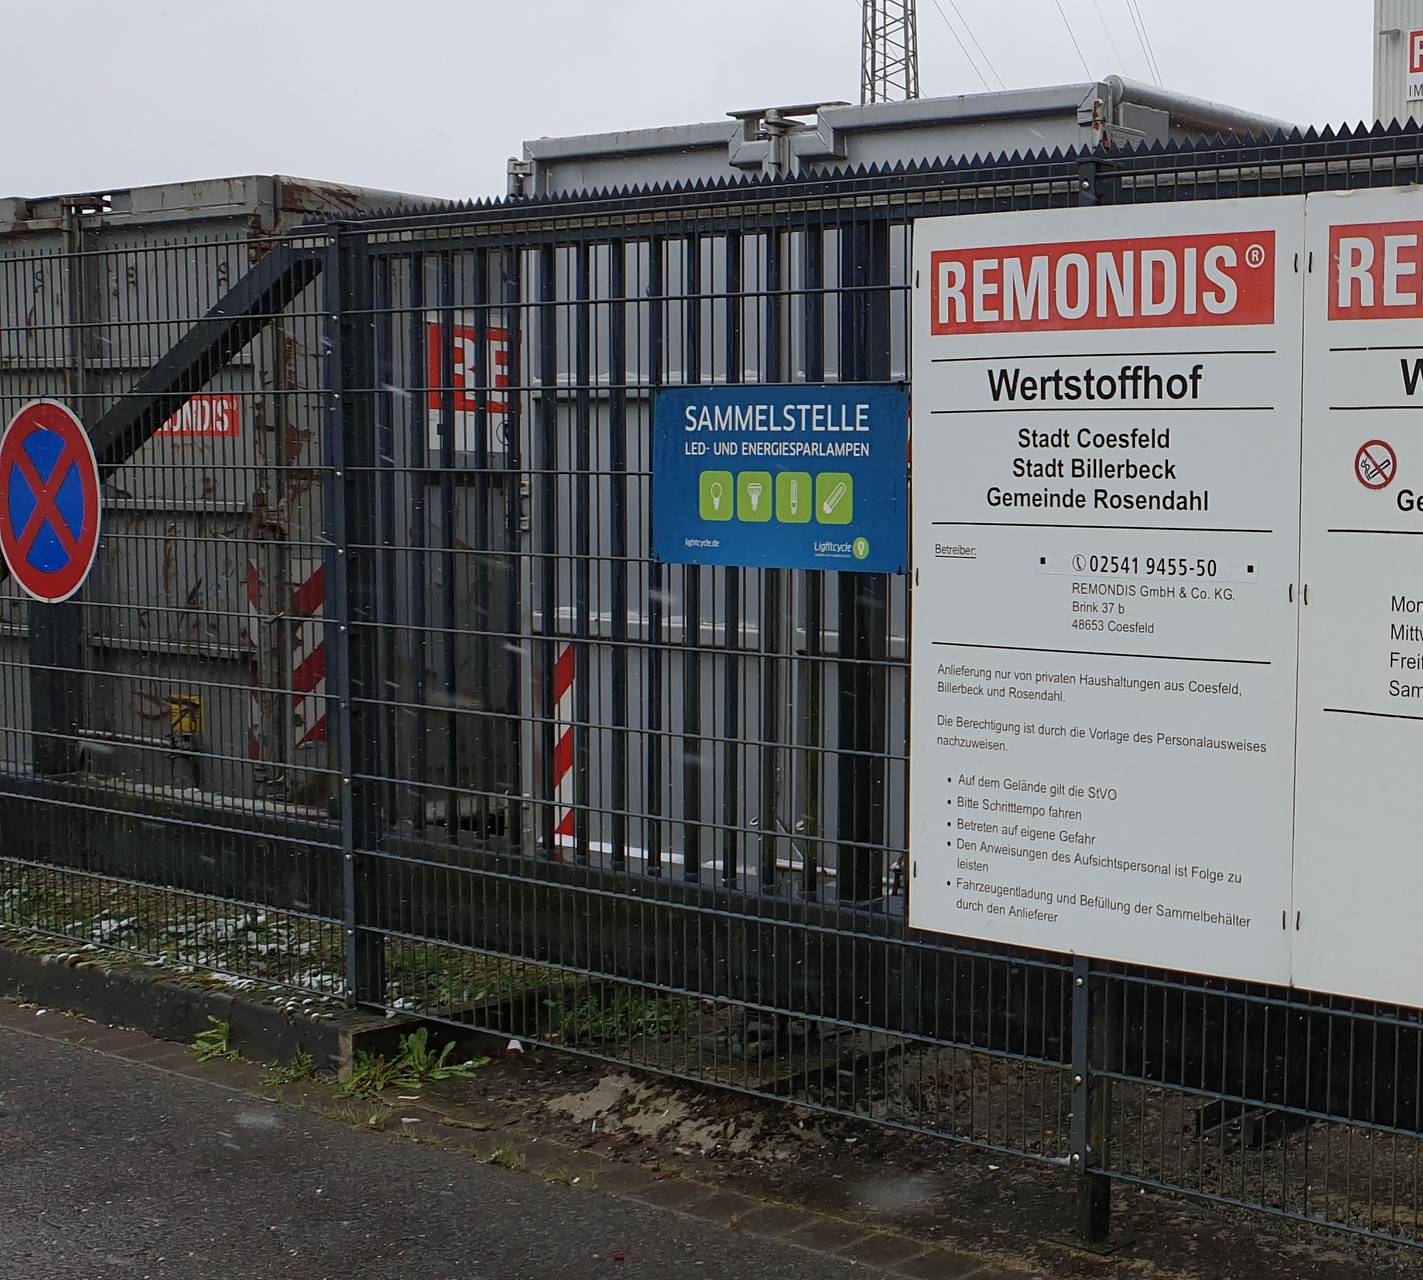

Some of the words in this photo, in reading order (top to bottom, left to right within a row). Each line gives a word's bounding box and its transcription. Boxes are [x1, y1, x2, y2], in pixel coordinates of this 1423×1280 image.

[1409, 84, 1423, 97] IM
[987, 364, 1203, 401] Wertstoffhof
[685, 404, 870, 432] SAMMELSTELLE
[1018, 428, 1070, 448] Stadt
[1077, 428, 1169, 448] Coesfeld
[685, 442, 710, 456] LED-
[714, 442, 738, 456] UND
[742, 442, 870, 457] ENERGIESPARLAMPEN
[1013, 458, 1064, 478] Stadt
[1072, 458, 1176, 479] Billerbeck
[987, 487, 1086, 508] Gemeinde
[1094, 489, 1208, 511] Rosendahl
[813, 541, 852, 553] Lightcycle
[935, 543, 976, 556] Betreiber:
[1090, 555, 1138, 574] 02541
[1146, 557, 1217, 577] 9455-50
[1072, 582, 1136, 596] REMONDIS
[1140, 585, 1175, 598] GmbH
[1179, 587, 1187, 598] &
[1191, 587, 1210, 599] Co.
[1072, 601, 1098, 613] Brink
[1102, 602, 1115, 613] 37
[1118, 603, 1125, 614] b
[1072, 619, 1104, 631] 48653
[1107, 620, 1154, 634] Coesfeld
[937, 664, 992, 681] Anlieferung
[995, 670, 1011, 679] nur
[1014, 672, 1032, 681] von
[1035, 671, 1076, 684] privaten
[1079, 674, 1160, 692] Haushaltungen
[1164, 682, 1184, 692] aus
[1188, 680, 1242, 697] Coesfeld,
[938, 681, 984, 696] Billerbeck
[987, 687, 1005, 697] und
[1009, 687, 1066, 702] Rosendahl.
[937, 714, 953, 727] Die
[956, 716, 1020, 736] Berechtigung
[1024, 722, 1035, 734] ist
[1038, 724, 1066, 736] durch
[1070, 726, 1085, 738] die
[1089, 728, 1129, 744] Vorlage
[1133, 731, 1153, 744] des
[1157, 733, 1266, 753] Personalausweises
[937, 736, 1008, 752] nachzuweisen.
[958, 774, 976, 786] Auf
[978, 776, 1000, 788] dem
[1003, 778, 1047, 793] Gelände
[1050, 784, 1065, 797] gilt
[1068, 785, 1084, 797] die
[1088, 786, 1117, 800] StVO
[957, 796, 979, 809] Bitte
[982, 798, 1045, 818] Schritttempo
[1049, 805, 1082, 820] fahren
[957, 818, 998, 834] Betreten
[1002, 825, 1018, 836] auf
[1020, 826, 1056, 841] eigene
[1059, 830, 1096, 845] Gefahr
[957, 838, 977, 851] Den
[980, 841, 1048, 861] Anweisungen
[1051, 850, 1071, 863] des
[1073, 852, 1171, 875] Aufsichtspersonal
[1175, 864, 1187, 877] ist
[1191, 866, 1224, 883] Folge
[1227, 873, 1242, 883] zu
[957, 857, 988, 872] leisten
[956, 877, 1053, 904] Fahrzeugentladung
[1057, 892, 1076, 906] und
[1080, 894, 1130, 915] Befüllung
[1134, 902, 1153, 915] der
[1156, 904, 1251, 928] Sammelbehälter
[956, 898, 983, 912] durch
[987, 903, 1005, 915] den
[1008, 905, 1058, 923] Anlieferer
